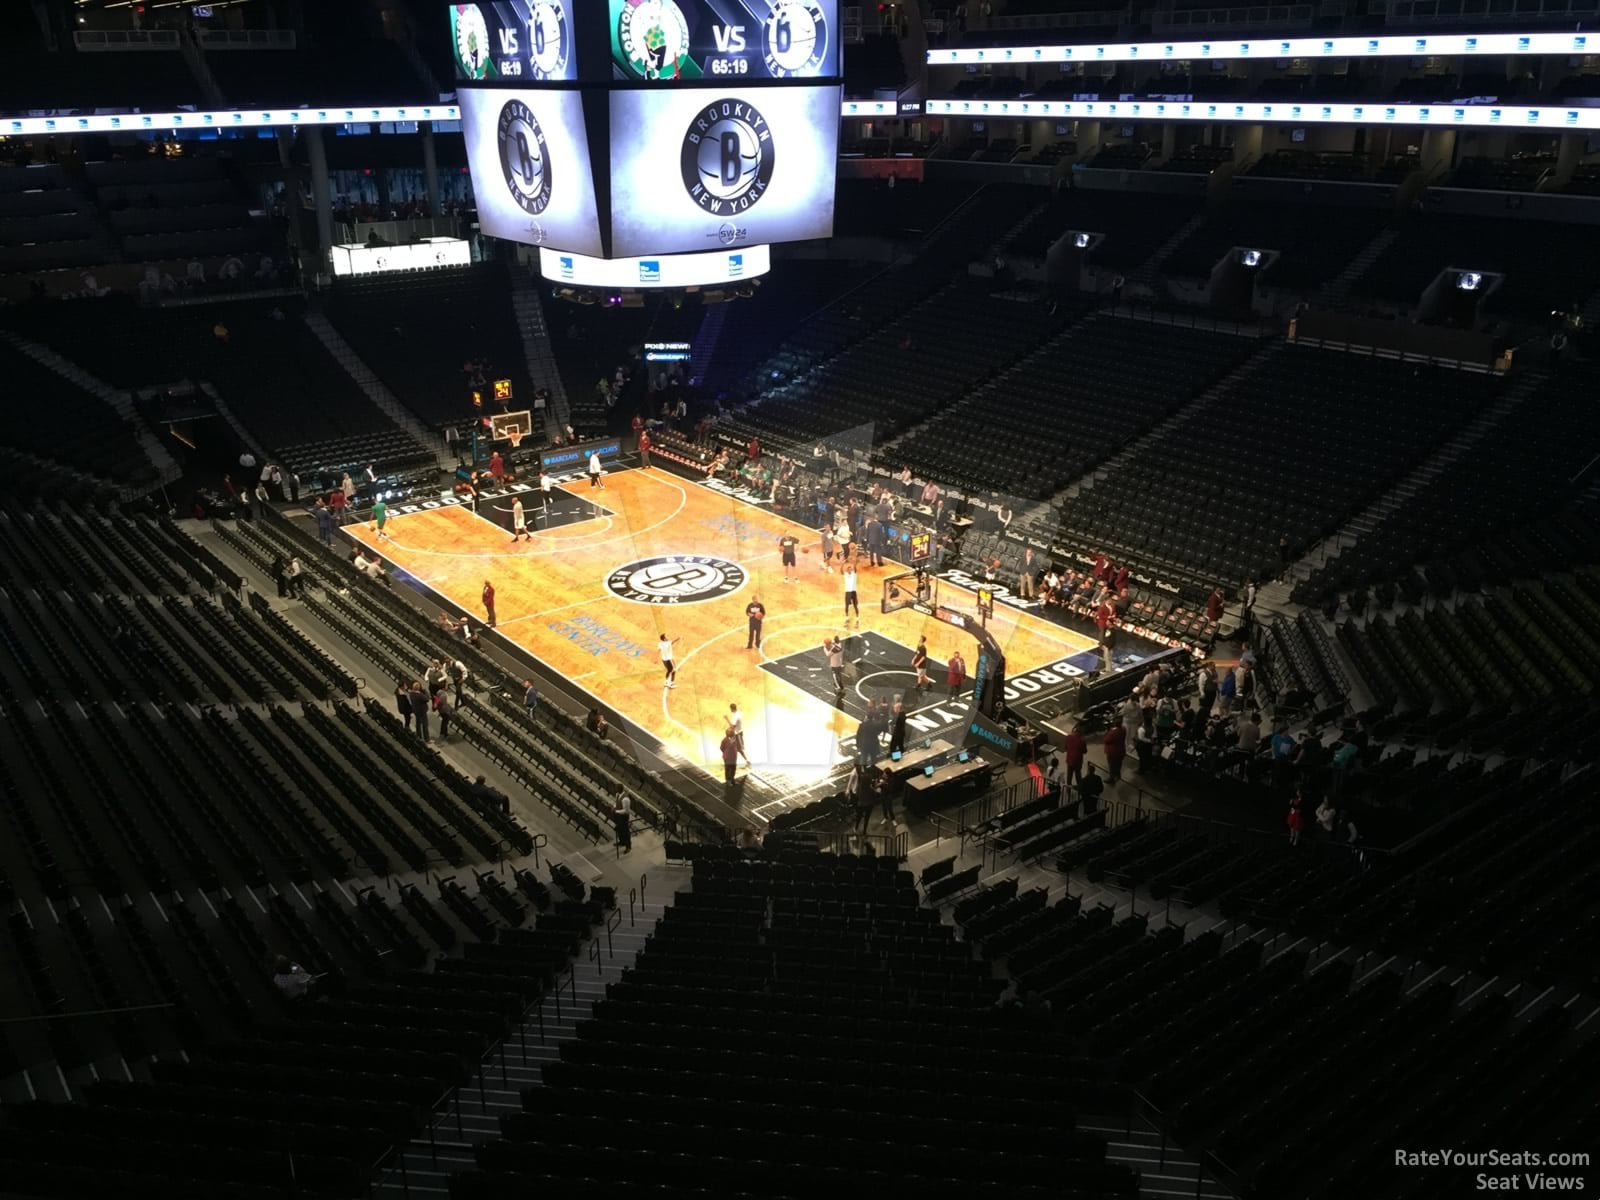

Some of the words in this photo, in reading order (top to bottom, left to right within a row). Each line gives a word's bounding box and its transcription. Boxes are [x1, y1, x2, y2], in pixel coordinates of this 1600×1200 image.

[499, 28, 519, 55] VS
[712, 25, 746, 52] VS
[501, 61, 522, 76] 65:19
[711, 59, 748, 74] 65:19
[499, 103, 545, 145] BROOKLYN
[689, 103, 770, 145] BROOKLYN
[720, 131, 742, 187] B
[691, 183, 722, 213] NEW
[730, 178, 766, 213] YORK
[497, 388, 509, 398] 24
[550, 451, 580, 464] BARCLAYS
[914, 543, 928, 557] 24
[665, 556, 742, 590] BROOKLYN
[624, 590, 679, 603] YORK
[979, 727, 1013, 751] BARCLAYS
